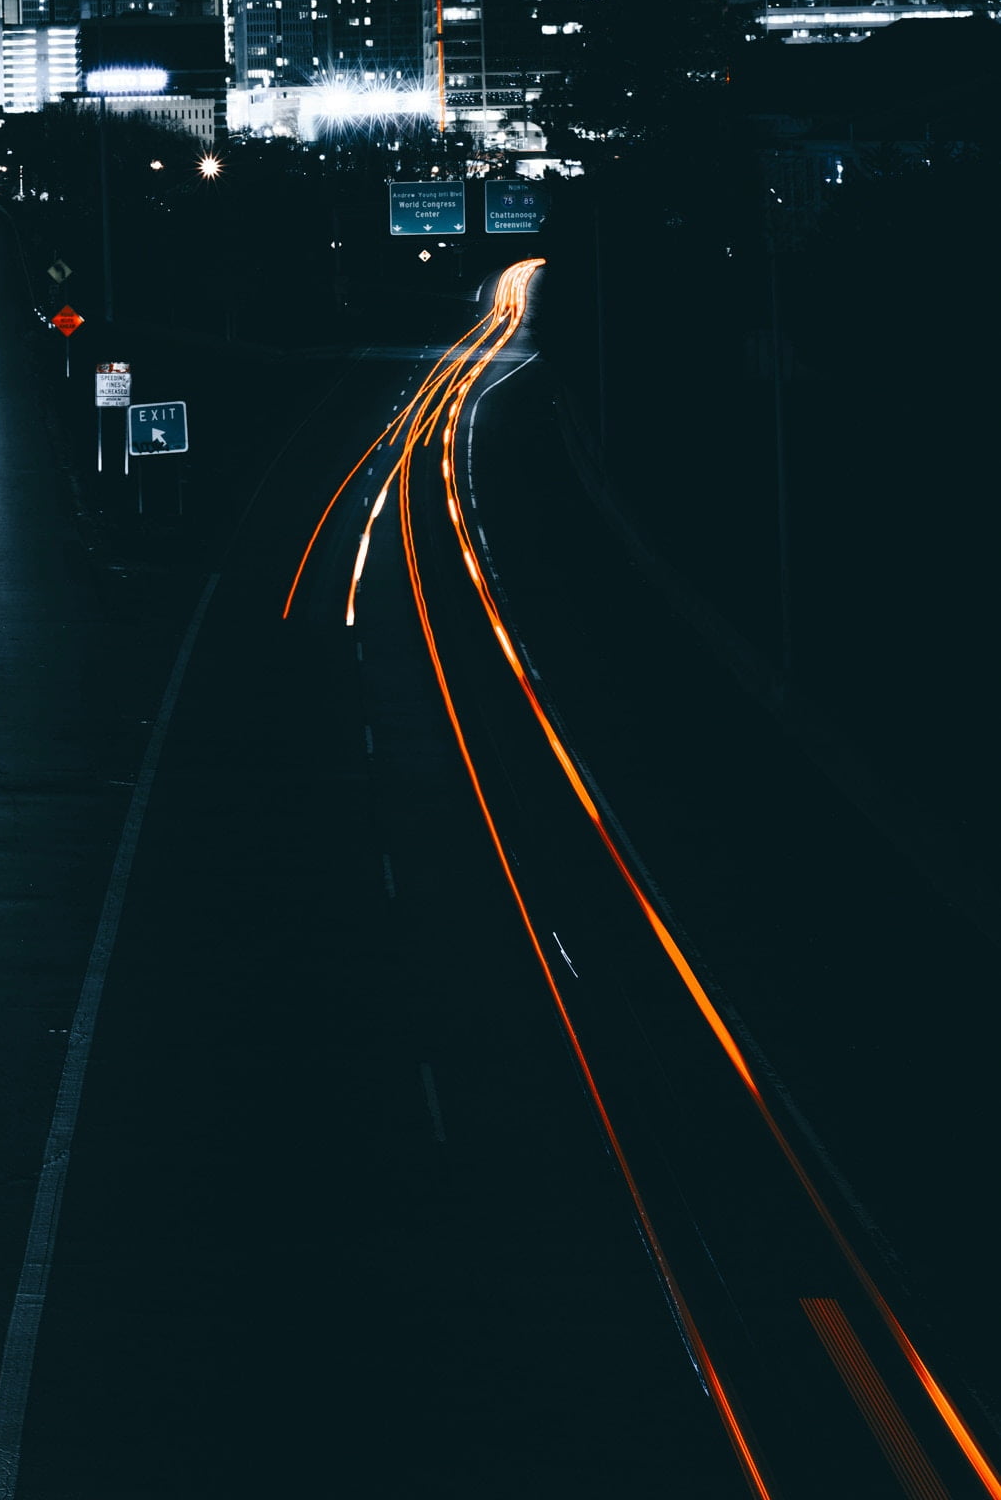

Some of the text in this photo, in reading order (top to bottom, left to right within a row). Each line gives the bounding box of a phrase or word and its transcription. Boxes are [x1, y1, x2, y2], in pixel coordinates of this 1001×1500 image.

[422, 201, 456, 209] Congress
[490, 211, 537, 219] Chattanooga
[139, 408, 176, 422] EXIT
